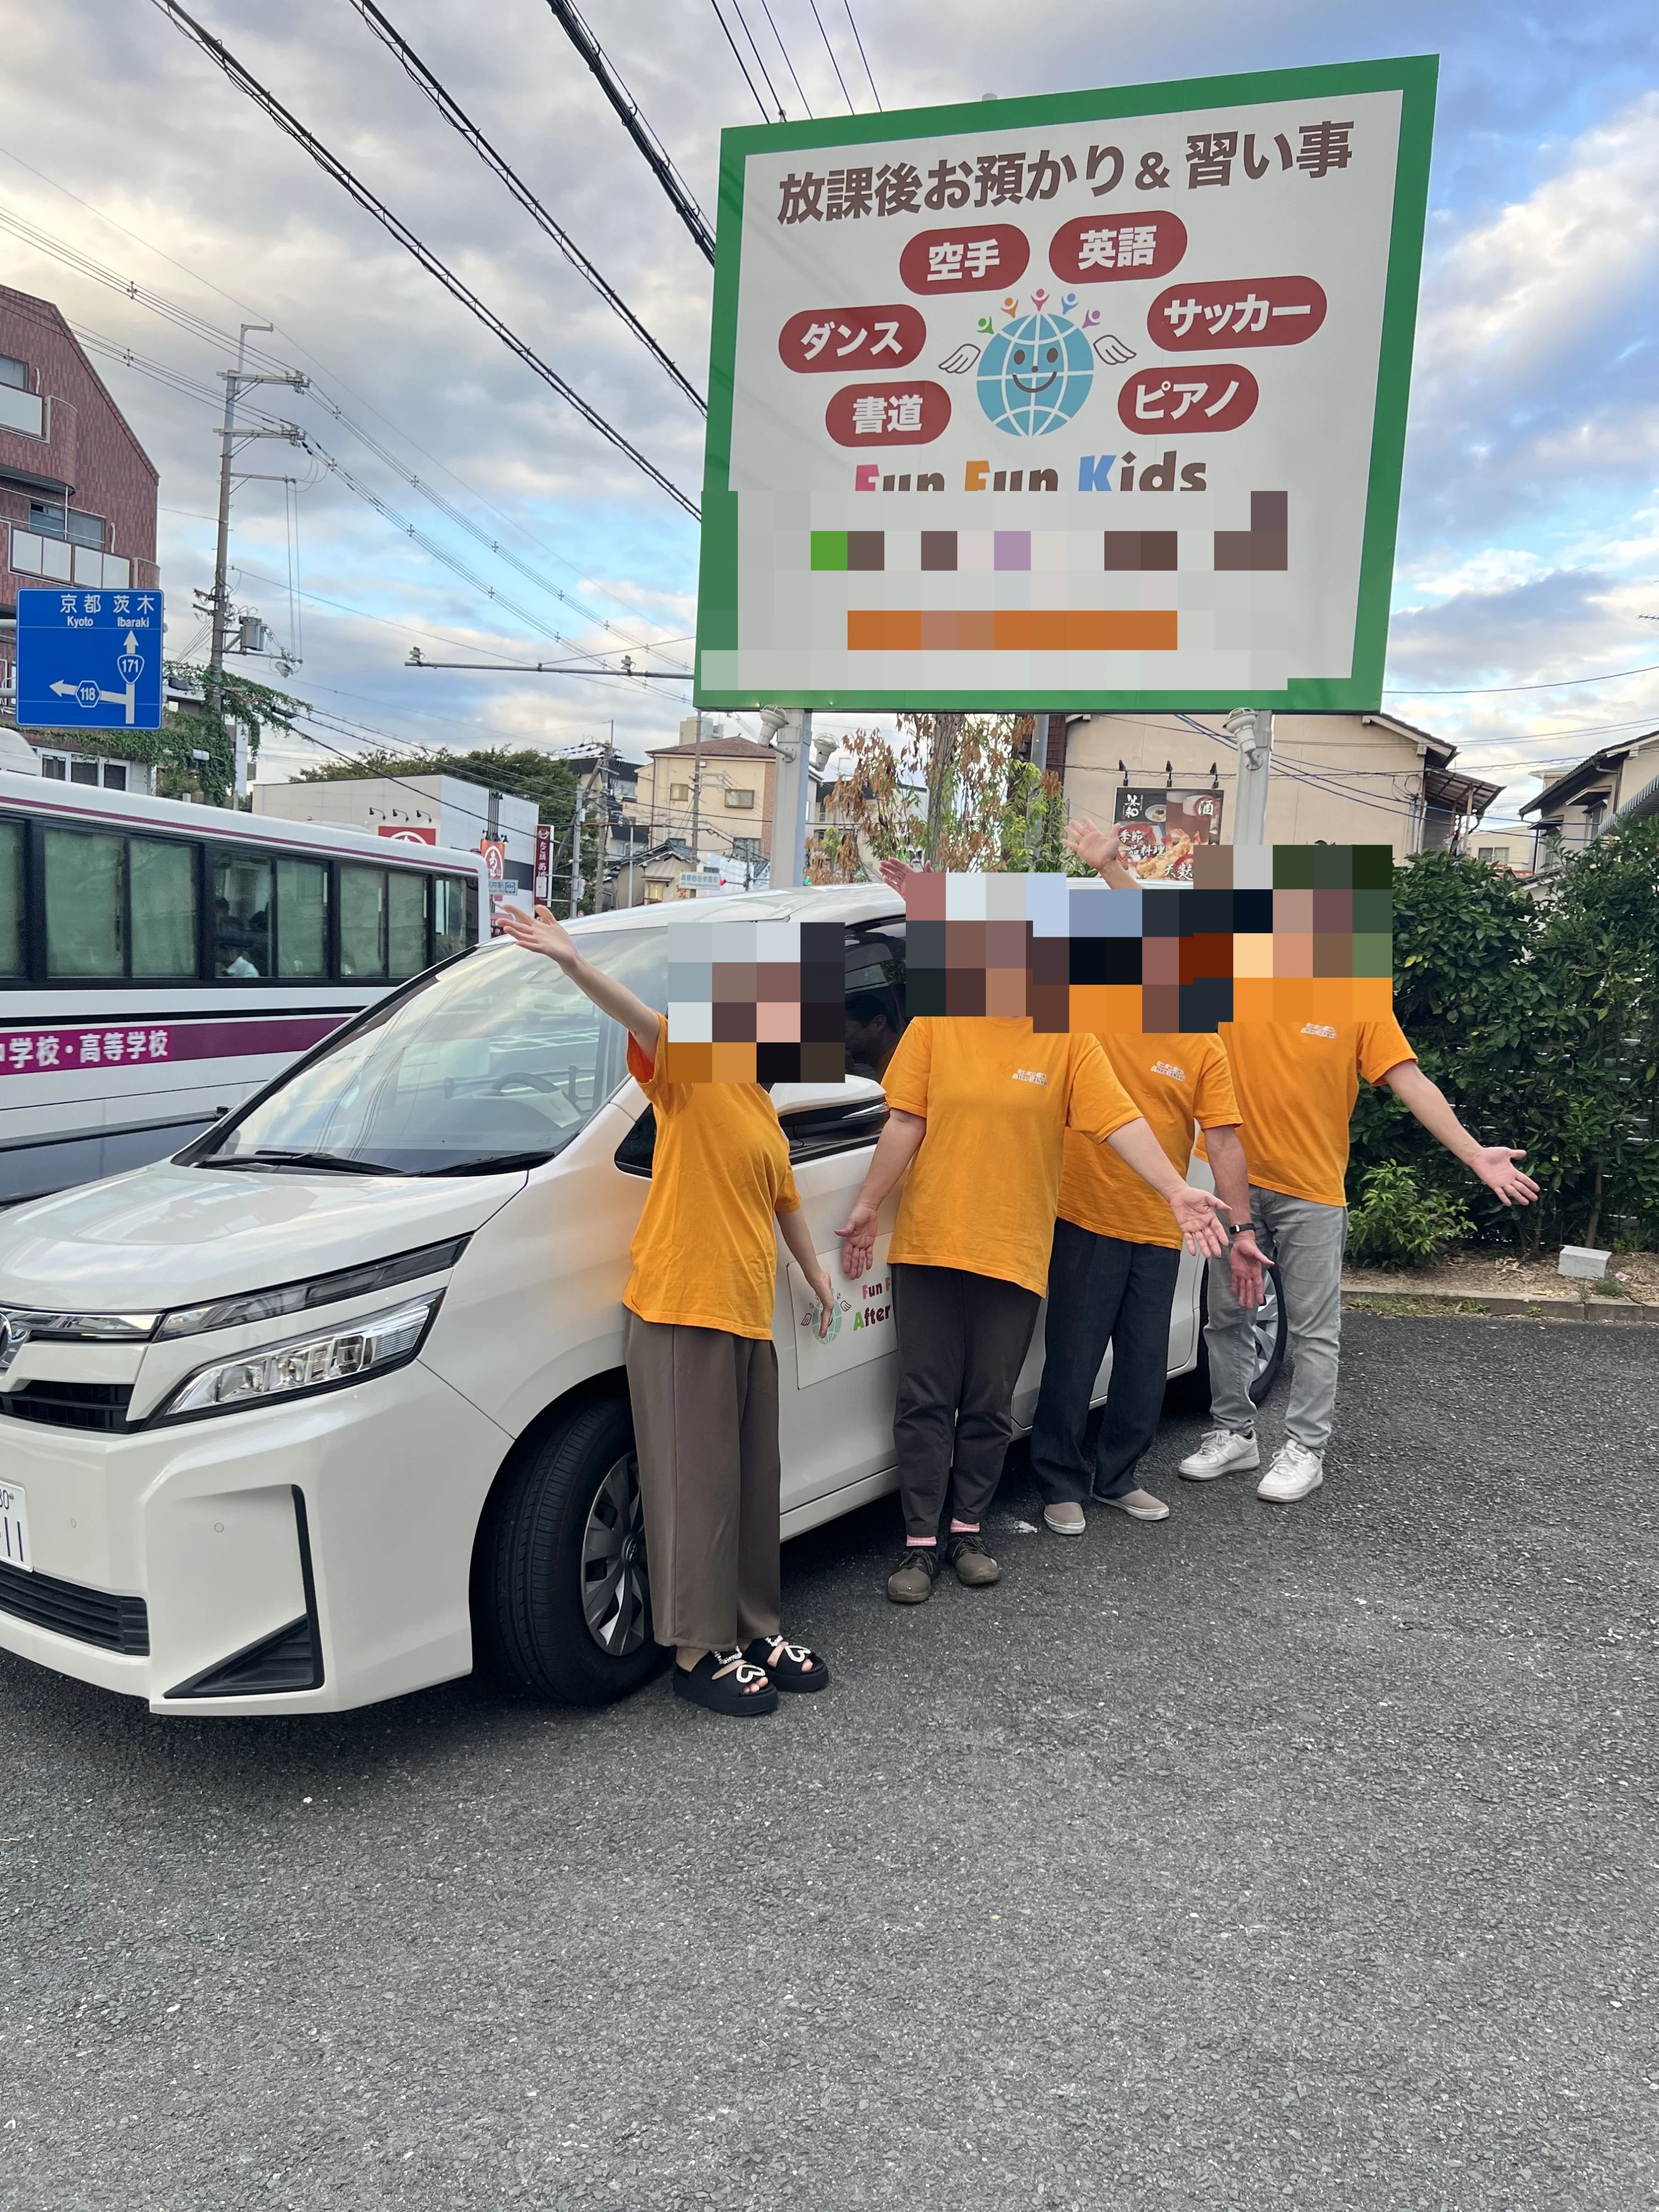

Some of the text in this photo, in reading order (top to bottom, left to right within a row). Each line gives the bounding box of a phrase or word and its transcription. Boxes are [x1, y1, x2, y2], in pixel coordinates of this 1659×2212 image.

[926, 238, 1000, 281] 空手
[1077, 225, 1157, 270] 英語
[1164, 294, 1311, 337] サッカー
[800, 320, 903, 361] ダンス
[852, 394, 924, 435] 書道
[1135, 380, 1240, 420] ピアノ
[1078, 450, 1207, 491] Kids
[60, 593, 155, 615] 京都 茨木
[66, 615, 150, 629] Kyoto Ibaraki
[121, 658, 139, 673] 171
[80, 687, 96, 701] 118
[1198, 800, 1214, 816] 酒
[1119, 830, 1143, 843] 季節
[0, 1030, 168, 1069] 学校・高等学校
[862, 1282, 883, 1300] Fun
[853, 1305, 891, 1331] After
